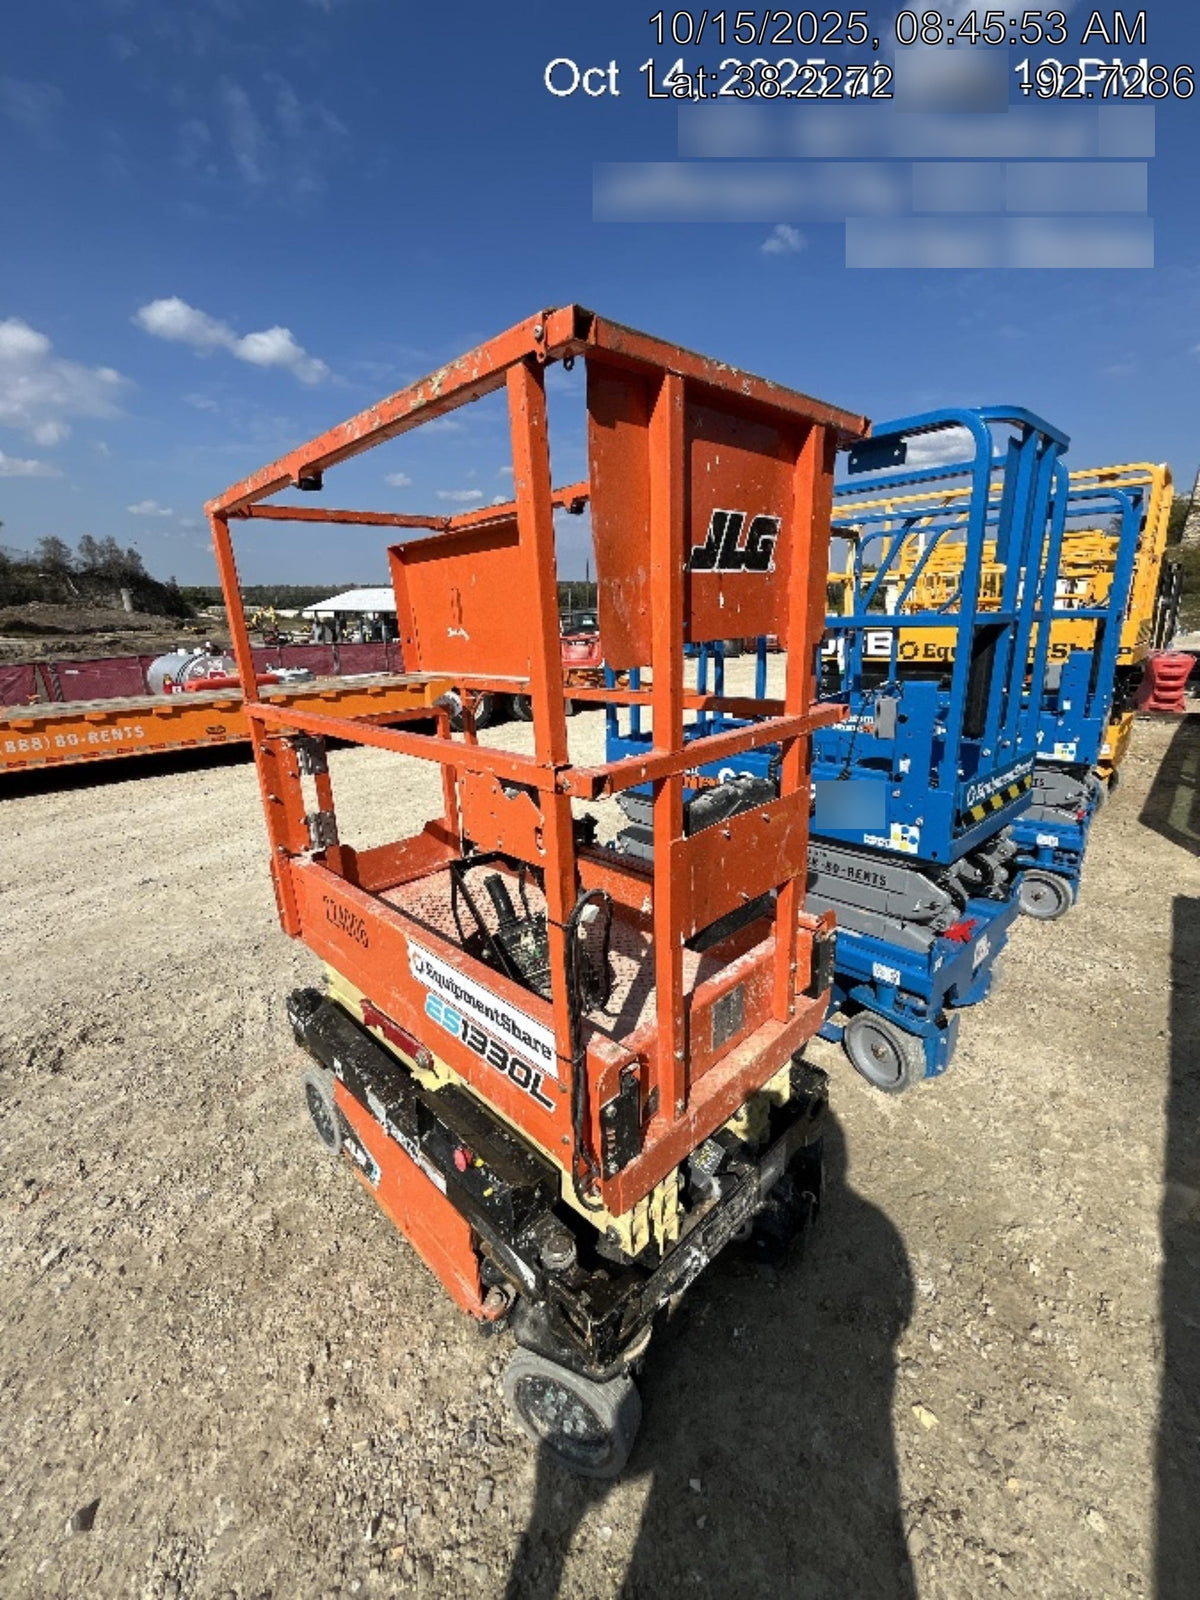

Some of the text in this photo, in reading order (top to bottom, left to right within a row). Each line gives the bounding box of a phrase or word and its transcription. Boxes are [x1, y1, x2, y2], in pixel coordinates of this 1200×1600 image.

[683, 508, 782, 573] JLG
[424, 961, 553, 1061] EquipmentShare
[424, 990, 556, 1113] ES1330L
